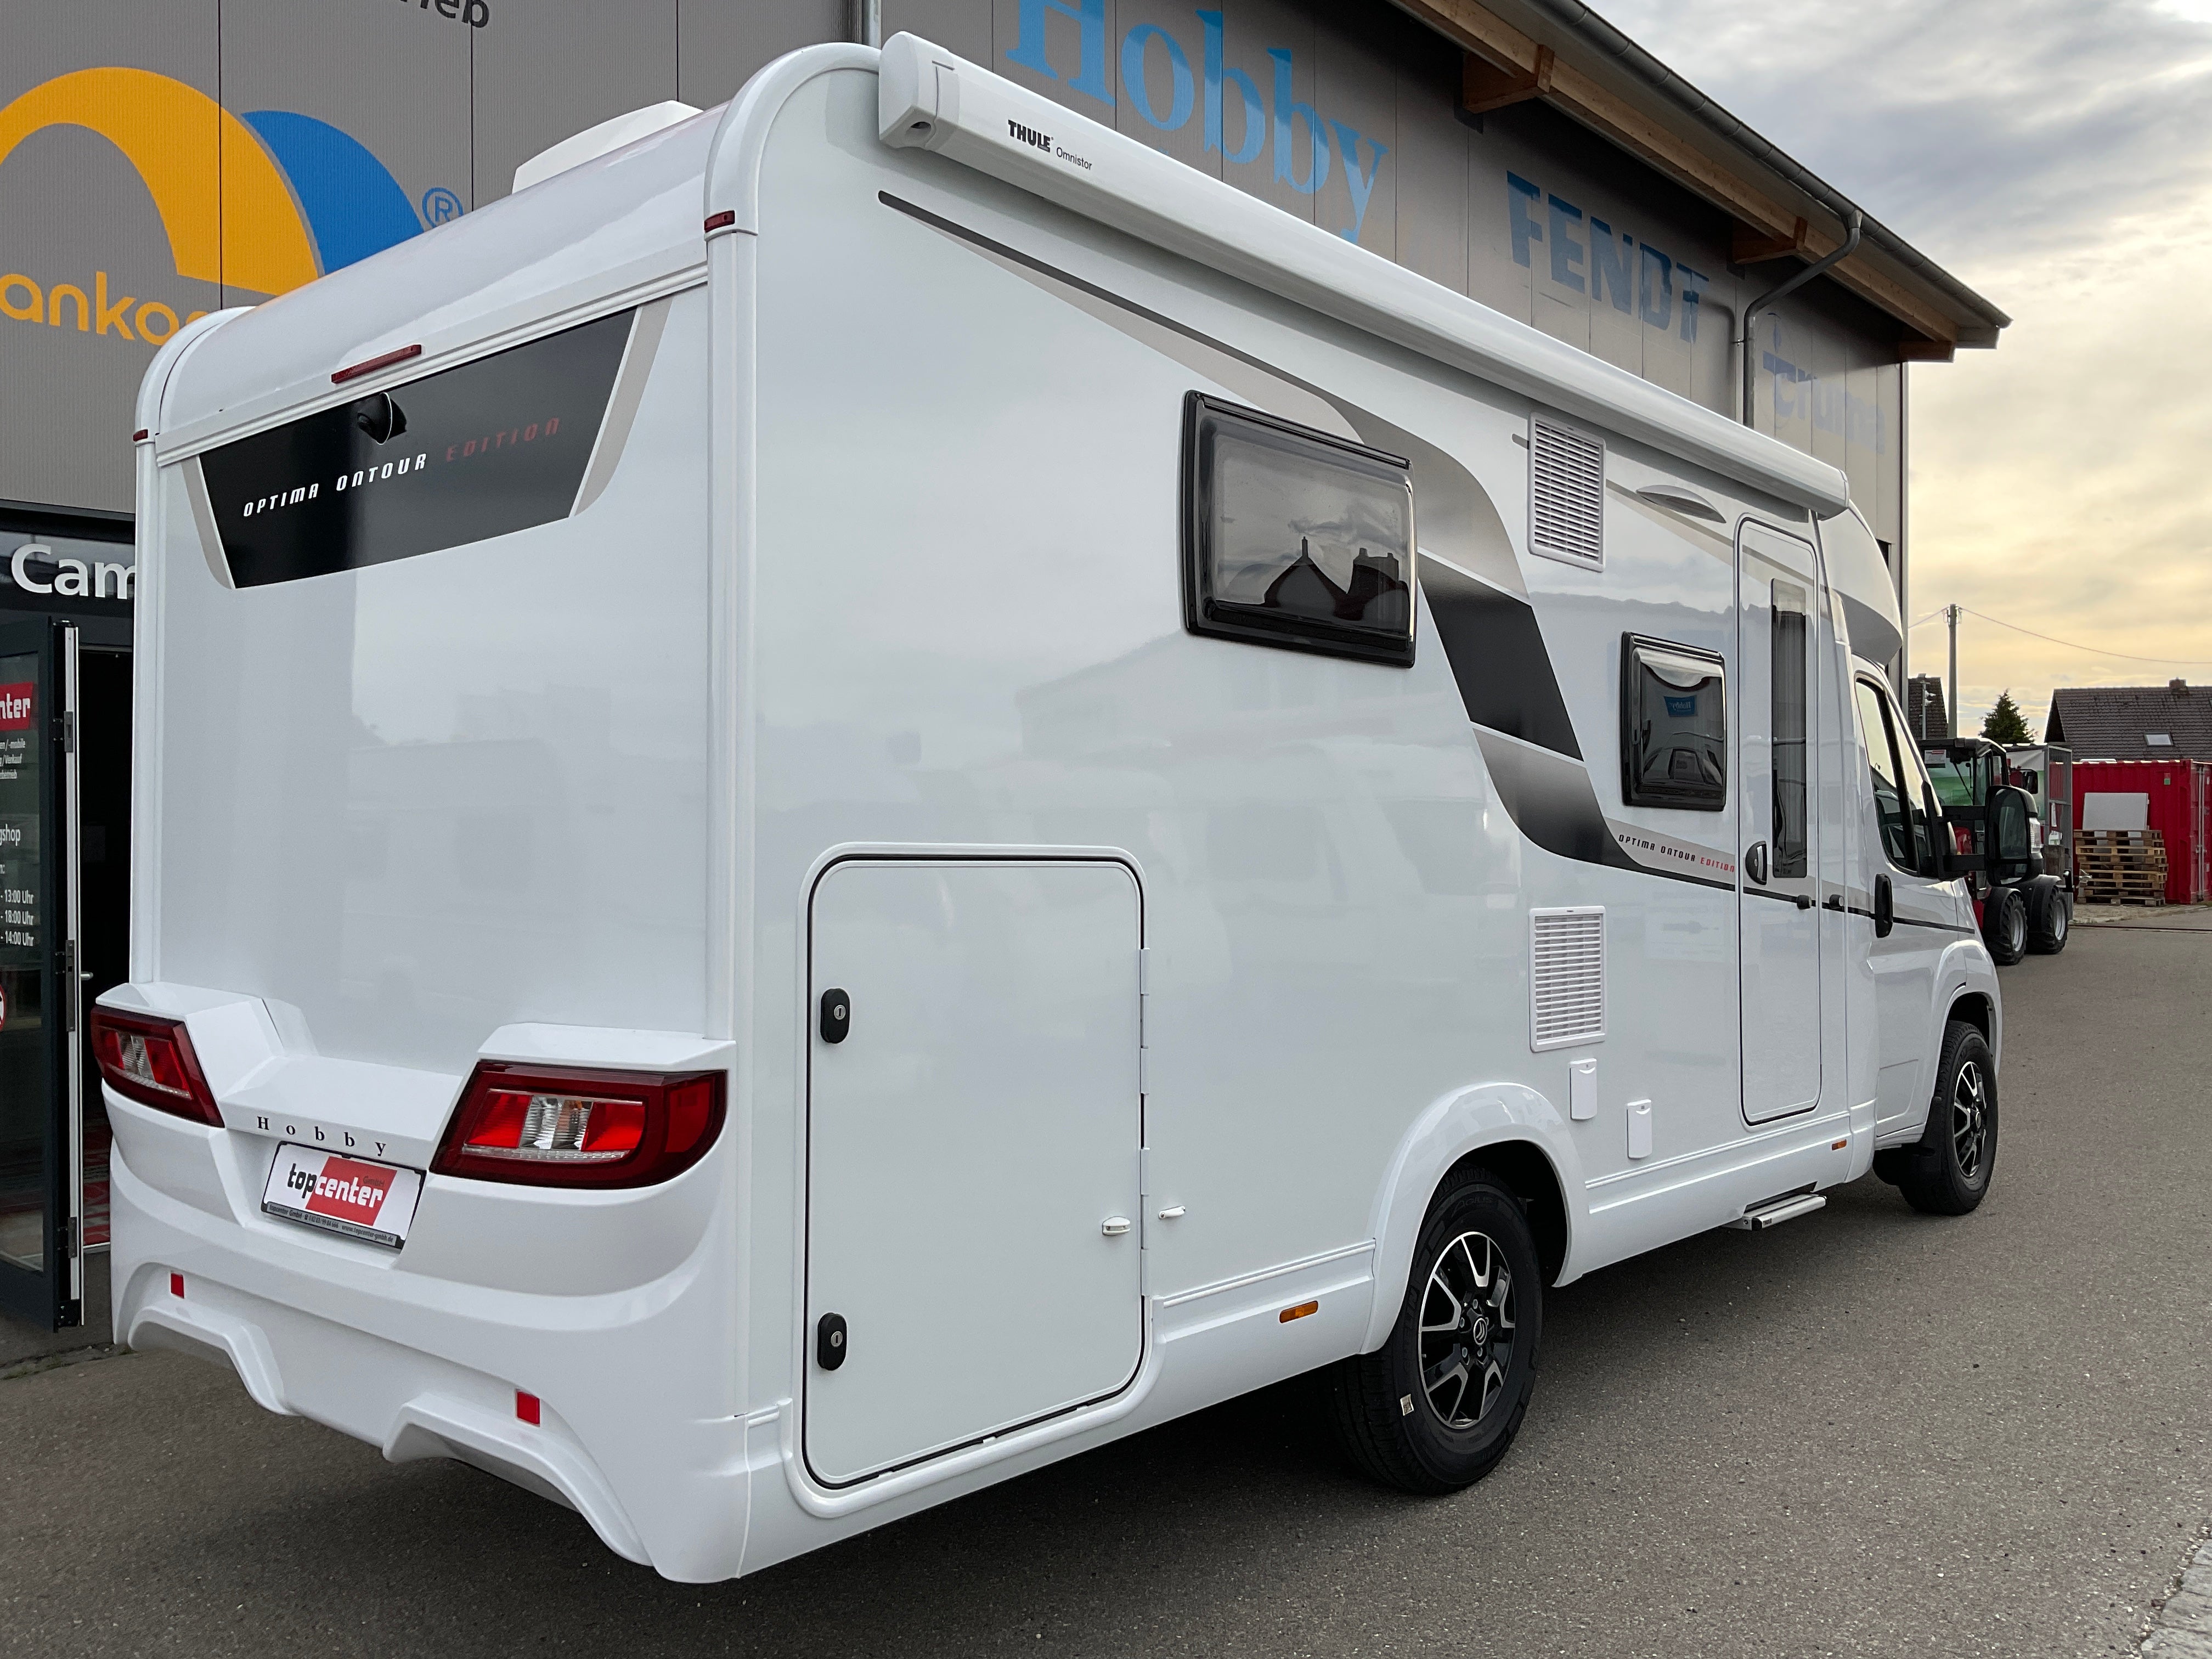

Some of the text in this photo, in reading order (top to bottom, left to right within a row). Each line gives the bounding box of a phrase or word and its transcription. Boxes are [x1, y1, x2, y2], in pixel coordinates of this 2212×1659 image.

[1056, 147, 1092, 171] Omnistor
[1506, 170, 1709, 344] FENDT
[243, 483, 319, 517] OPTIMA
[11, 543, 136, 600] Cam
[1618, 834, 1655, 851] OPTIMA
[4, 889, 21, 904] 13:00
[22, 890, 34, 904] Uhr
[5, 910, 21, 924] 18:00
[22, 911, 34, 926] Uhr
[5, 930, 21, 945] 14:00
[22, 932, 34, 946] Uhr
[257, 1116, 387, 1156] Hobby
[287, 1163, 383, 1208] topcenter
